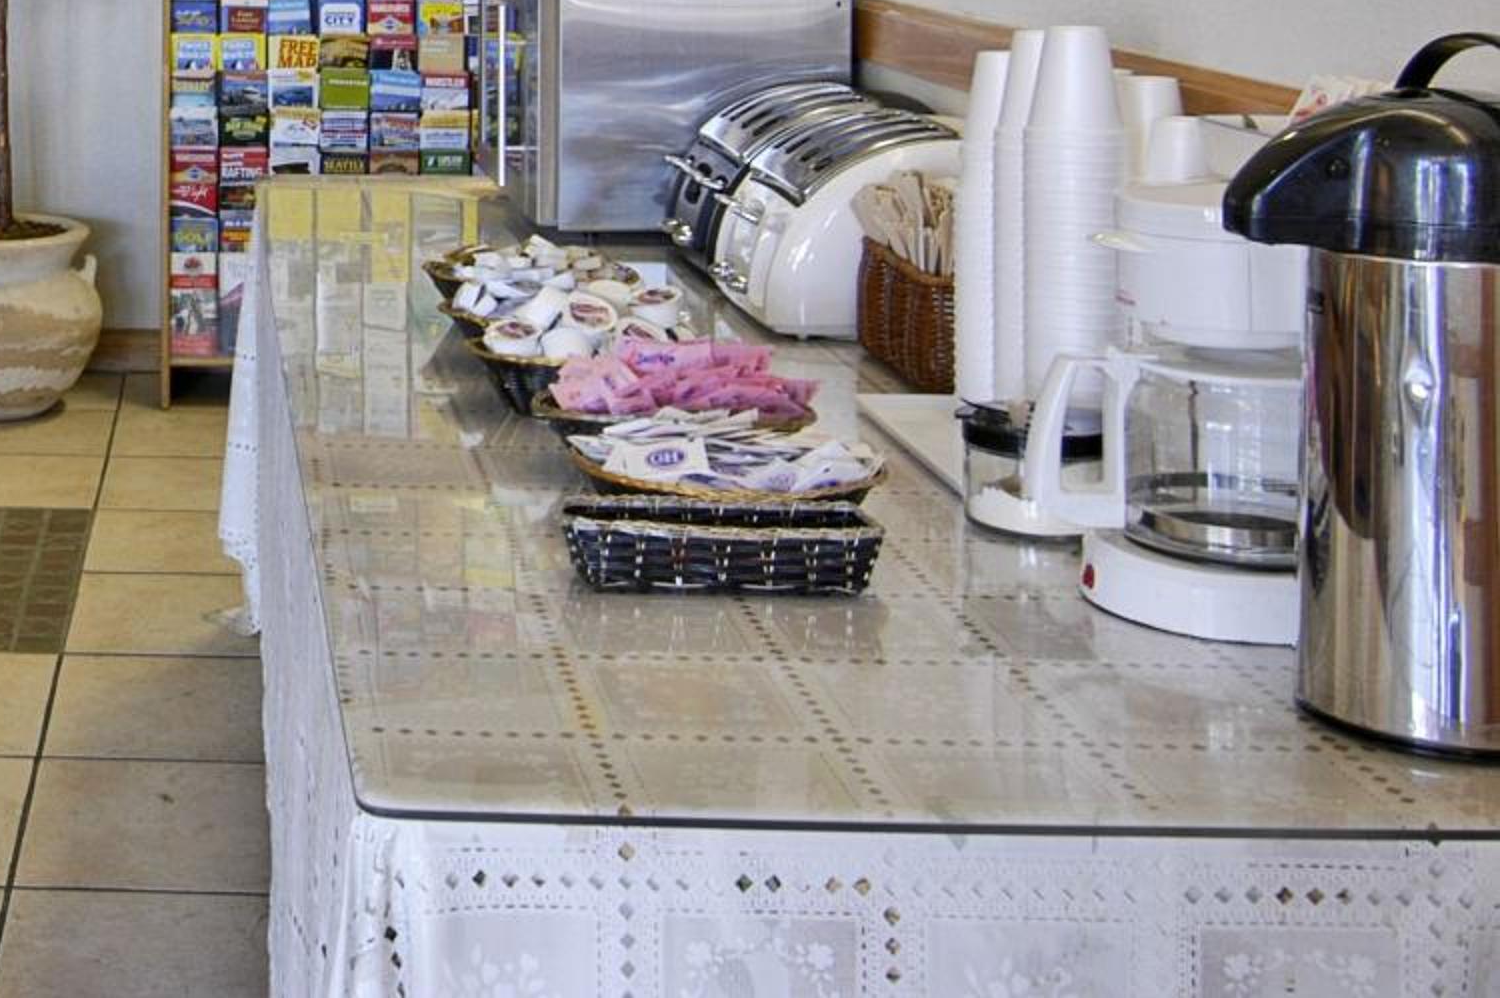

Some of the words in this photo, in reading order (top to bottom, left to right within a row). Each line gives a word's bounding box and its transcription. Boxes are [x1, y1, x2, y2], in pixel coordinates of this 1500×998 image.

[325, 15, 354, 26] CITY
[280, 40, 318, 55] FREE
[278, 55, 318, 68] MAP
